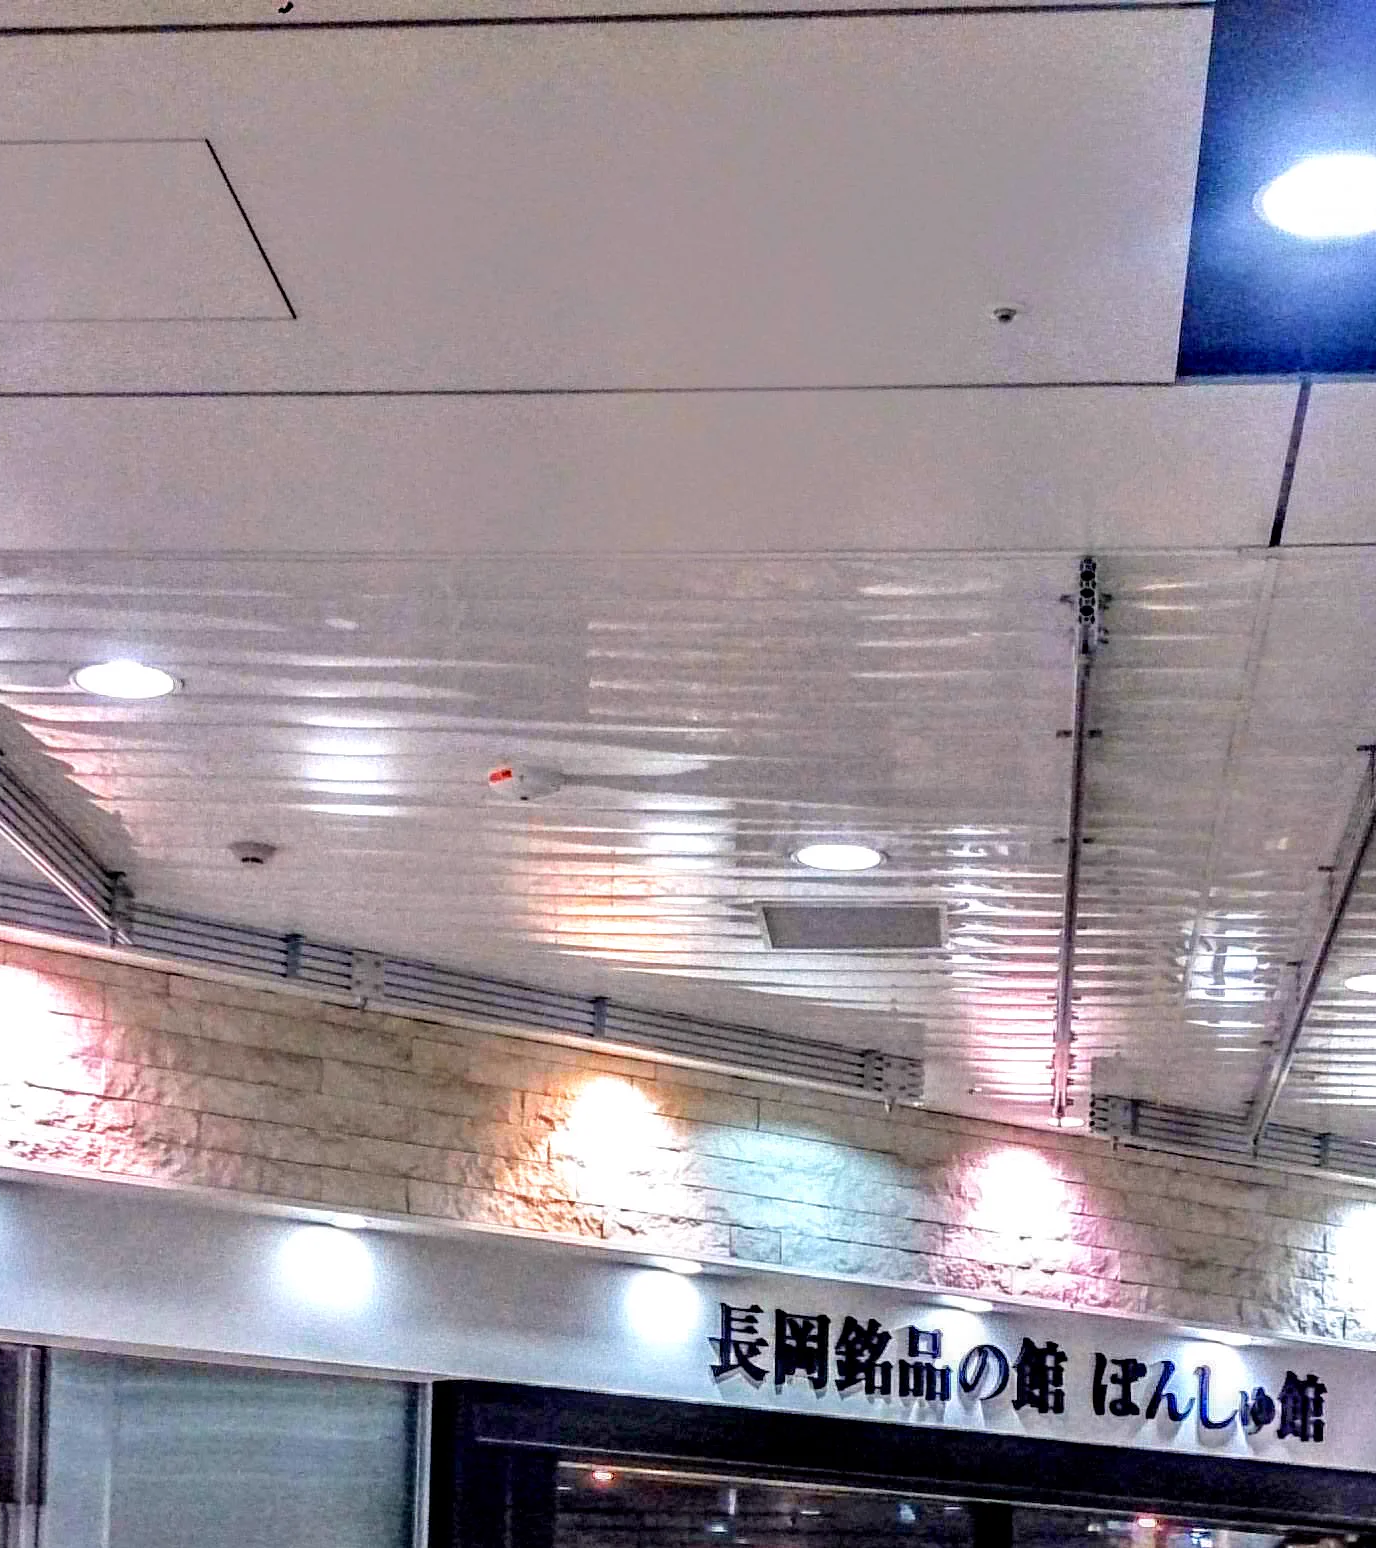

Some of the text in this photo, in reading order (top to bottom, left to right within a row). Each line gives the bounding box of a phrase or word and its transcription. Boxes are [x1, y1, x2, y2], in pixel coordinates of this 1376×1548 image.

[708, 1302, 1328, 1443] 長岡銘品の館 ぽんしゅ館
